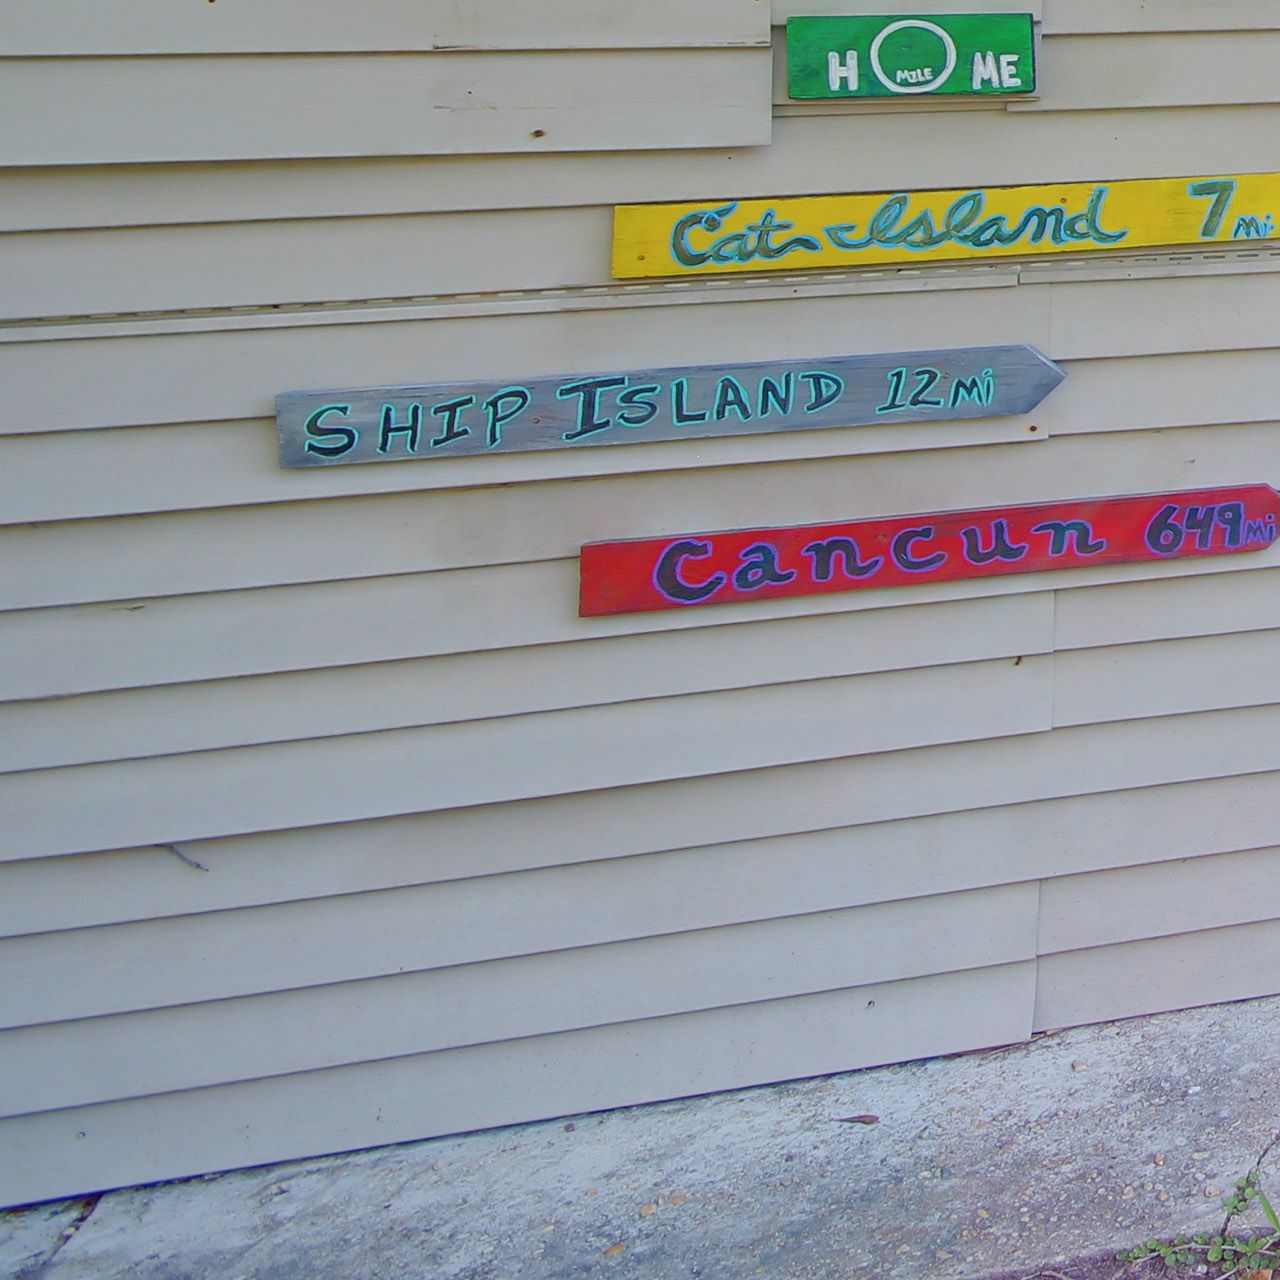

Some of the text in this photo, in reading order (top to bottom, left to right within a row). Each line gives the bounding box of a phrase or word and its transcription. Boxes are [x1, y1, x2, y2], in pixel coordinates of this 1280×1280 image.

[668, 202, 824, 270] Cat
[824, 186, 1127, 250] Island
[1187, 179, 1237, 239] 7
[303, 387, 530, 462] SHIP
[557, 370, 844, 444] ISLAND
[652, 519, 1106, 605] Cancun
[1145, 501, 1244, 555] 649
